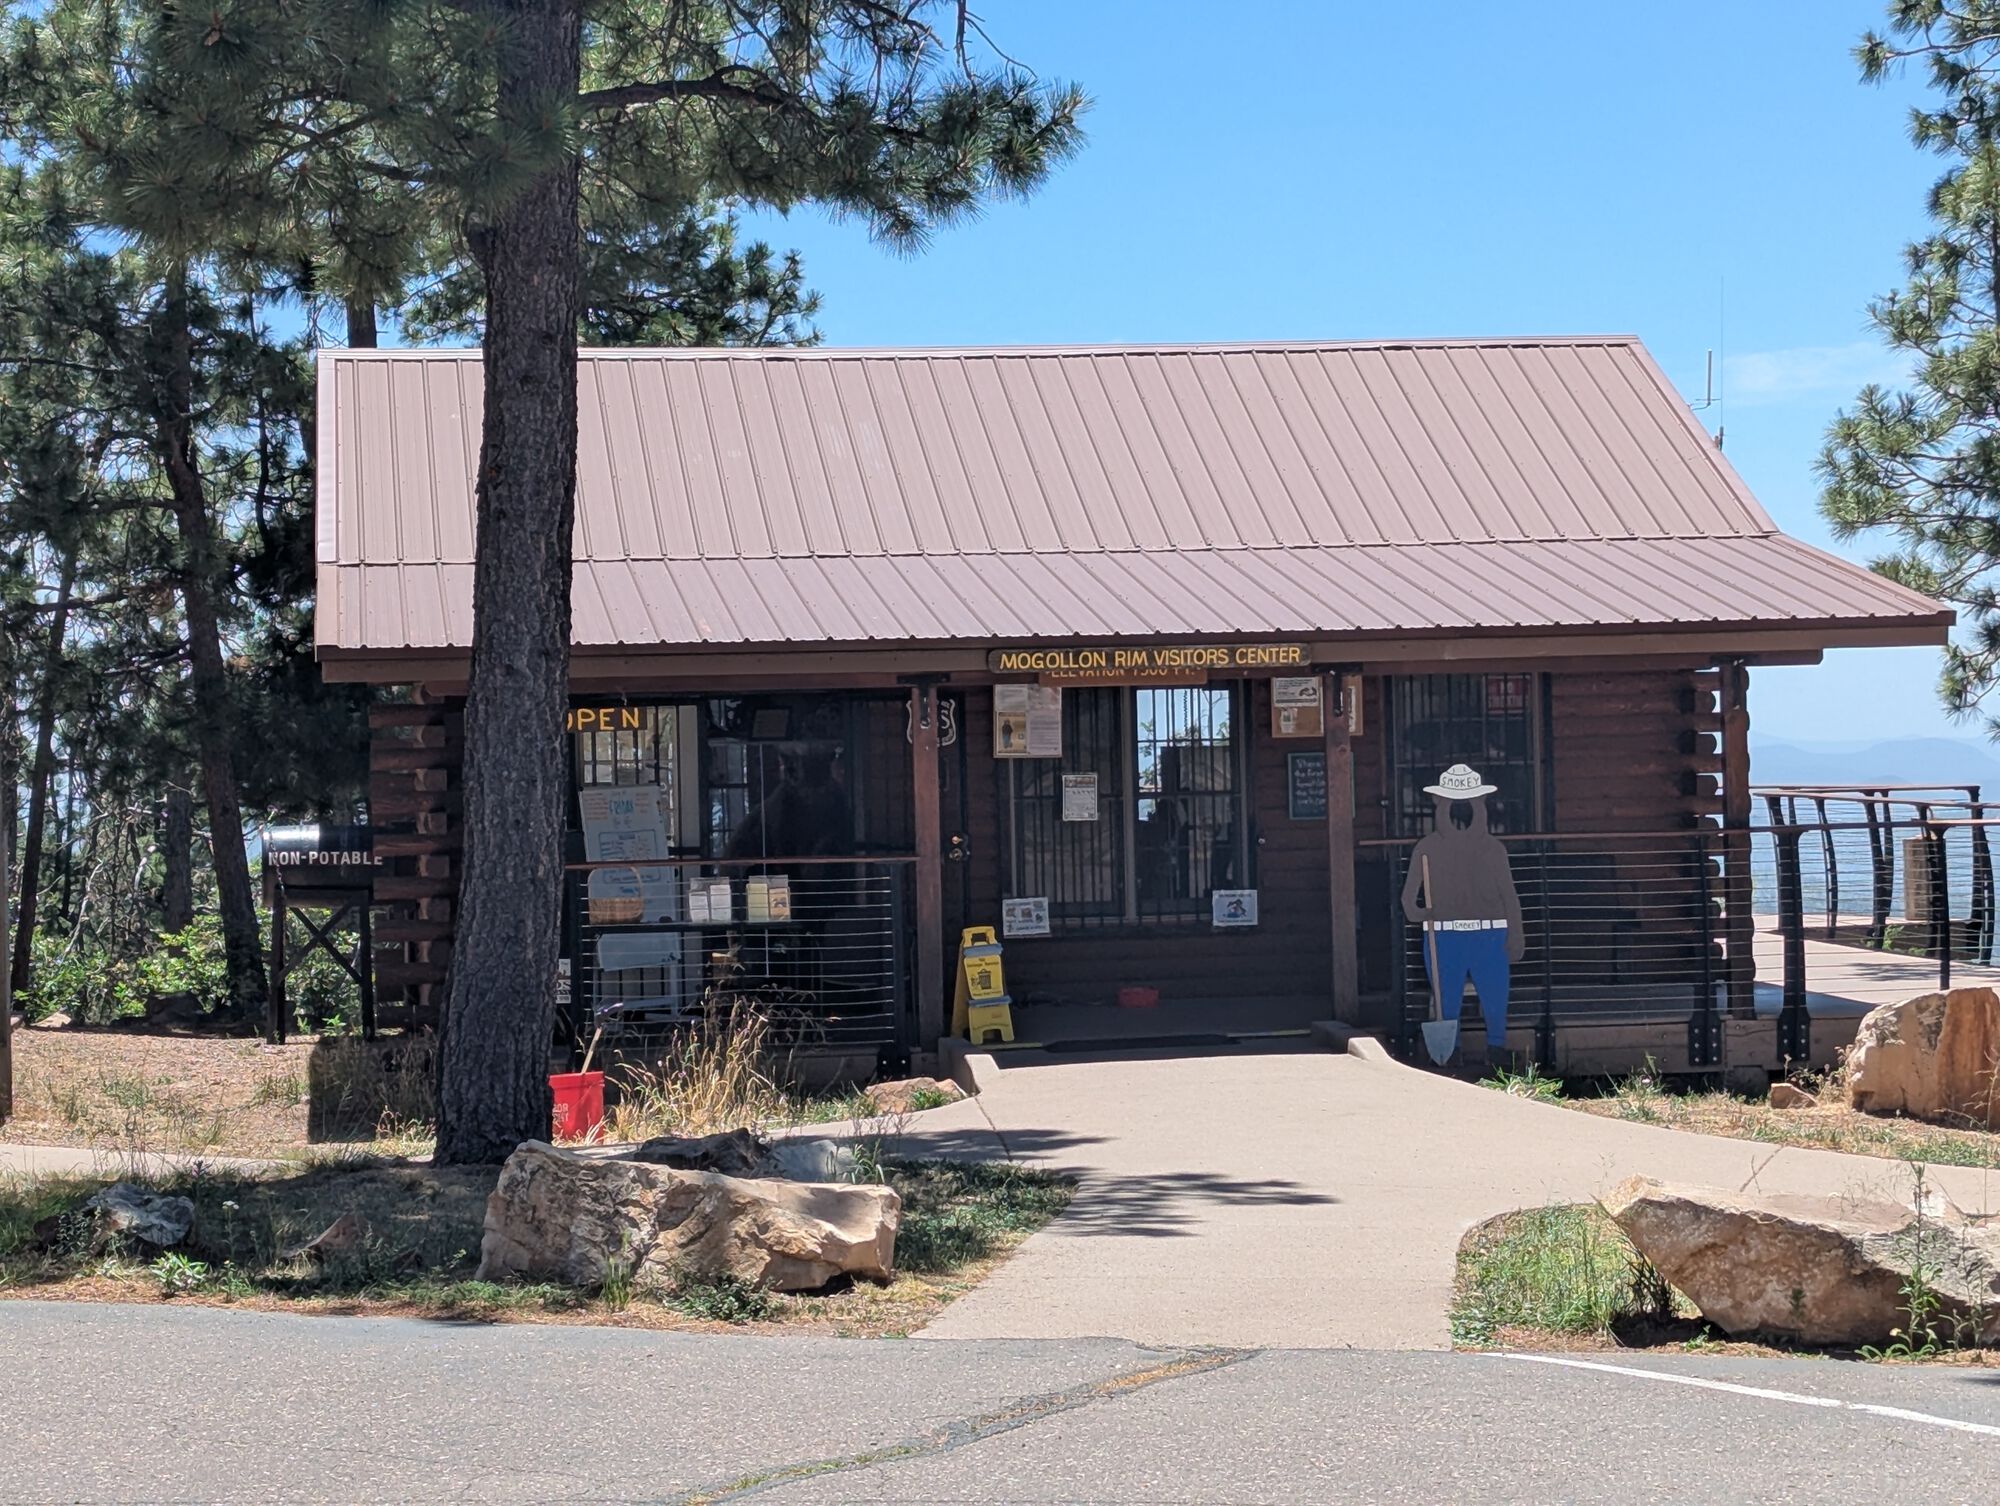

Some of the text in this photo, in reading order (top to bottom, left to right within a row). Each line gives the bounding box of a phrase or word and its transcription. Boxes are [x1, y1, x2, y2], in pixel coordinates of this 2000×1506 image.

[1000, 646, 1301, 670] MOGOLLON RIM VISITORS CENTER
[1440, 776, 1480, 788] SMOKEY
[268, 851, 383, 866] NON-POTABLE
[1454, 921, 1480, 930] SMOKEY
